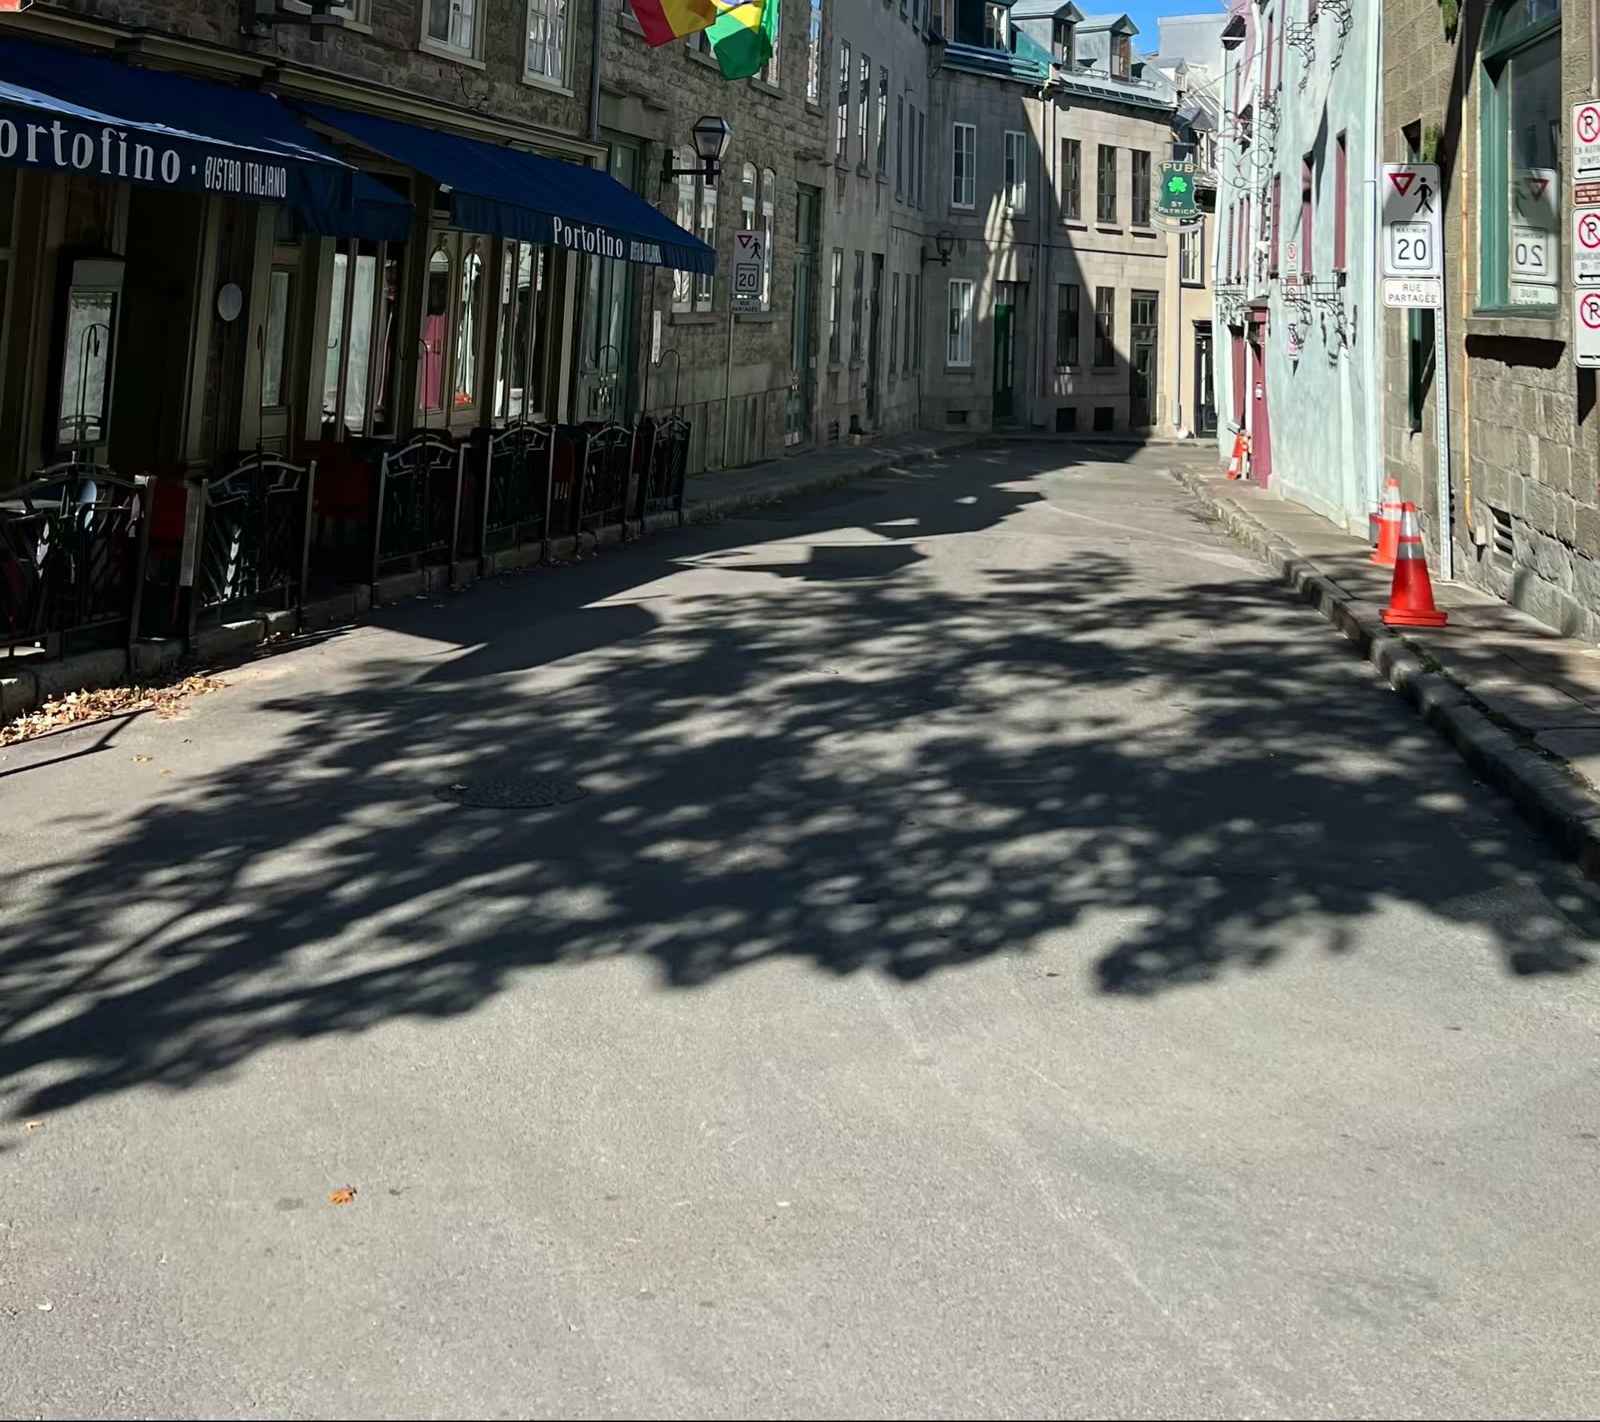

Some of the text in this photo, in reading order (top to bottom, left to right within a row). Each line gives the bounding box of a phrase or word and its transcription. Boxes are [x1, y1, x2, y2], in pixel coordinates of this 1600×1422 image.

[0, 119, 287, 198] ortofino BISTRO ITALIANO
[1162, 163, 1194, 173] PUB
[553, 216, 624, 258] Portofino
[1397, 238, 1427, 261] 20
[739, 273, 756, 287] 20
[1402, 283, 1422, 292] RUE
[1388, 293, 1437, 303] PARTAGÉE
